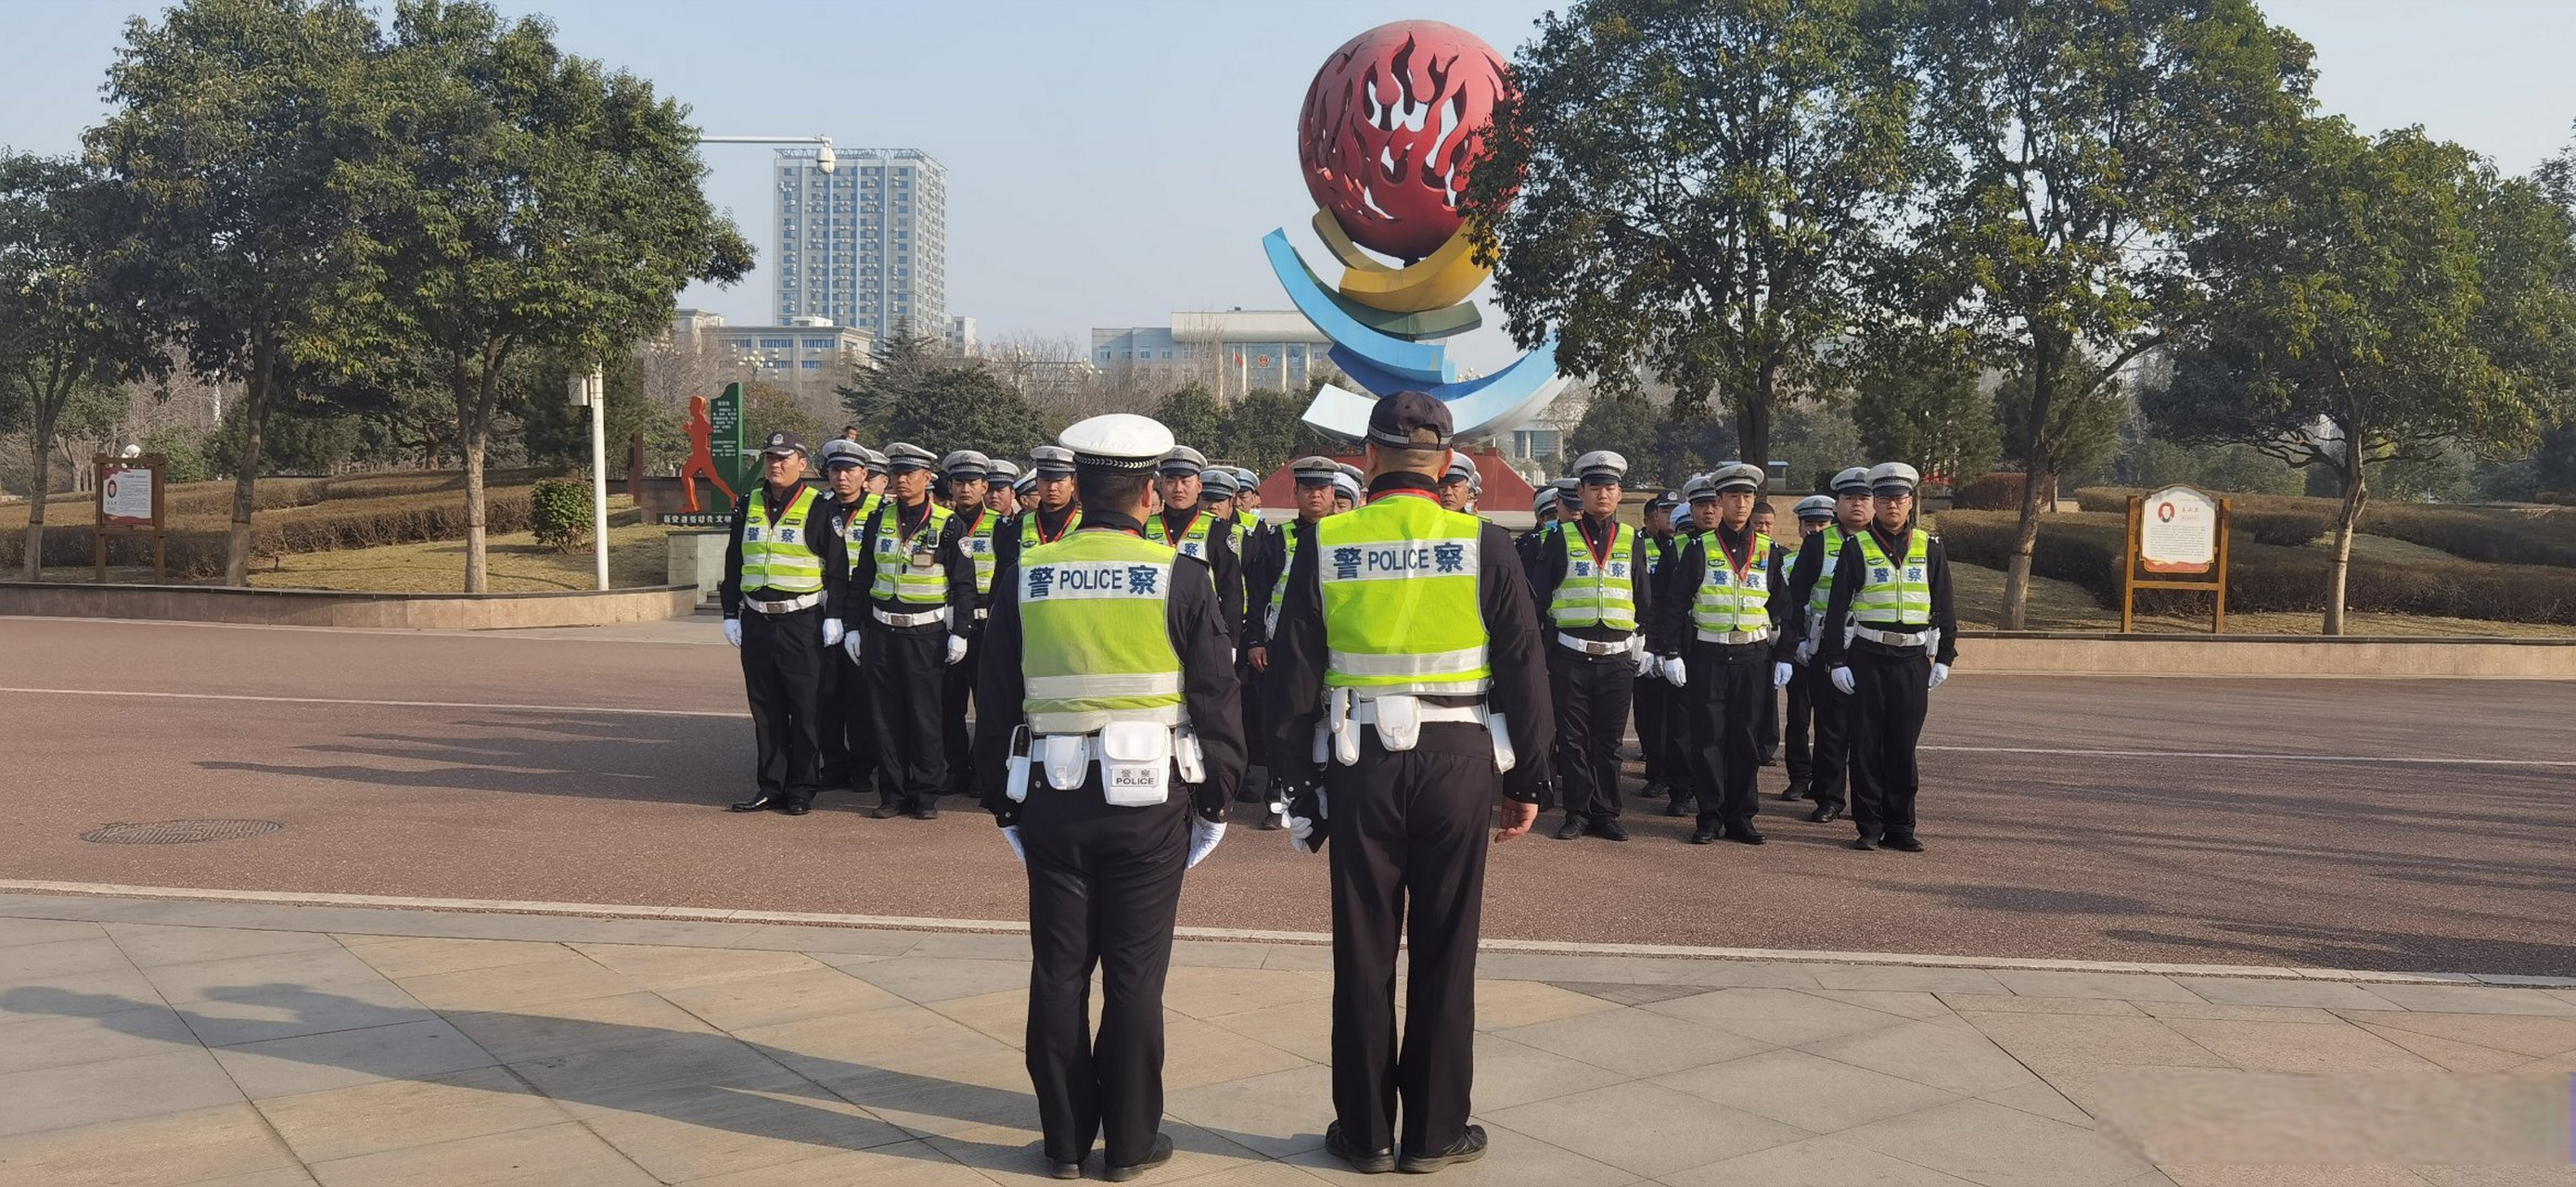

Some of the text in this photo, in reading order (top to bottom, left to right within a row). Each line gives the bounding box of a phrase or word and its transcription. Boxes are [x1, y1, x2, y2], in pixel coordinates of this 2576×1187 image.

[748, 527, 795, 542] 警 察
[852, 529, 863, 541] 察
[880, 539, 893, 552] 警
[973, 540, 985, 553] 察
[1184, 542, 1198, 556] 察
[1333, 542, 1464, 580] 警 POLICE 察
[1574, 561, 1625, 578] 警 察
[1874, 567, 1922, 582] 警 察
[1028, 564, 1158, 599] 警 POLICE 察
[1713, 570, 1760, 588] 警 察
